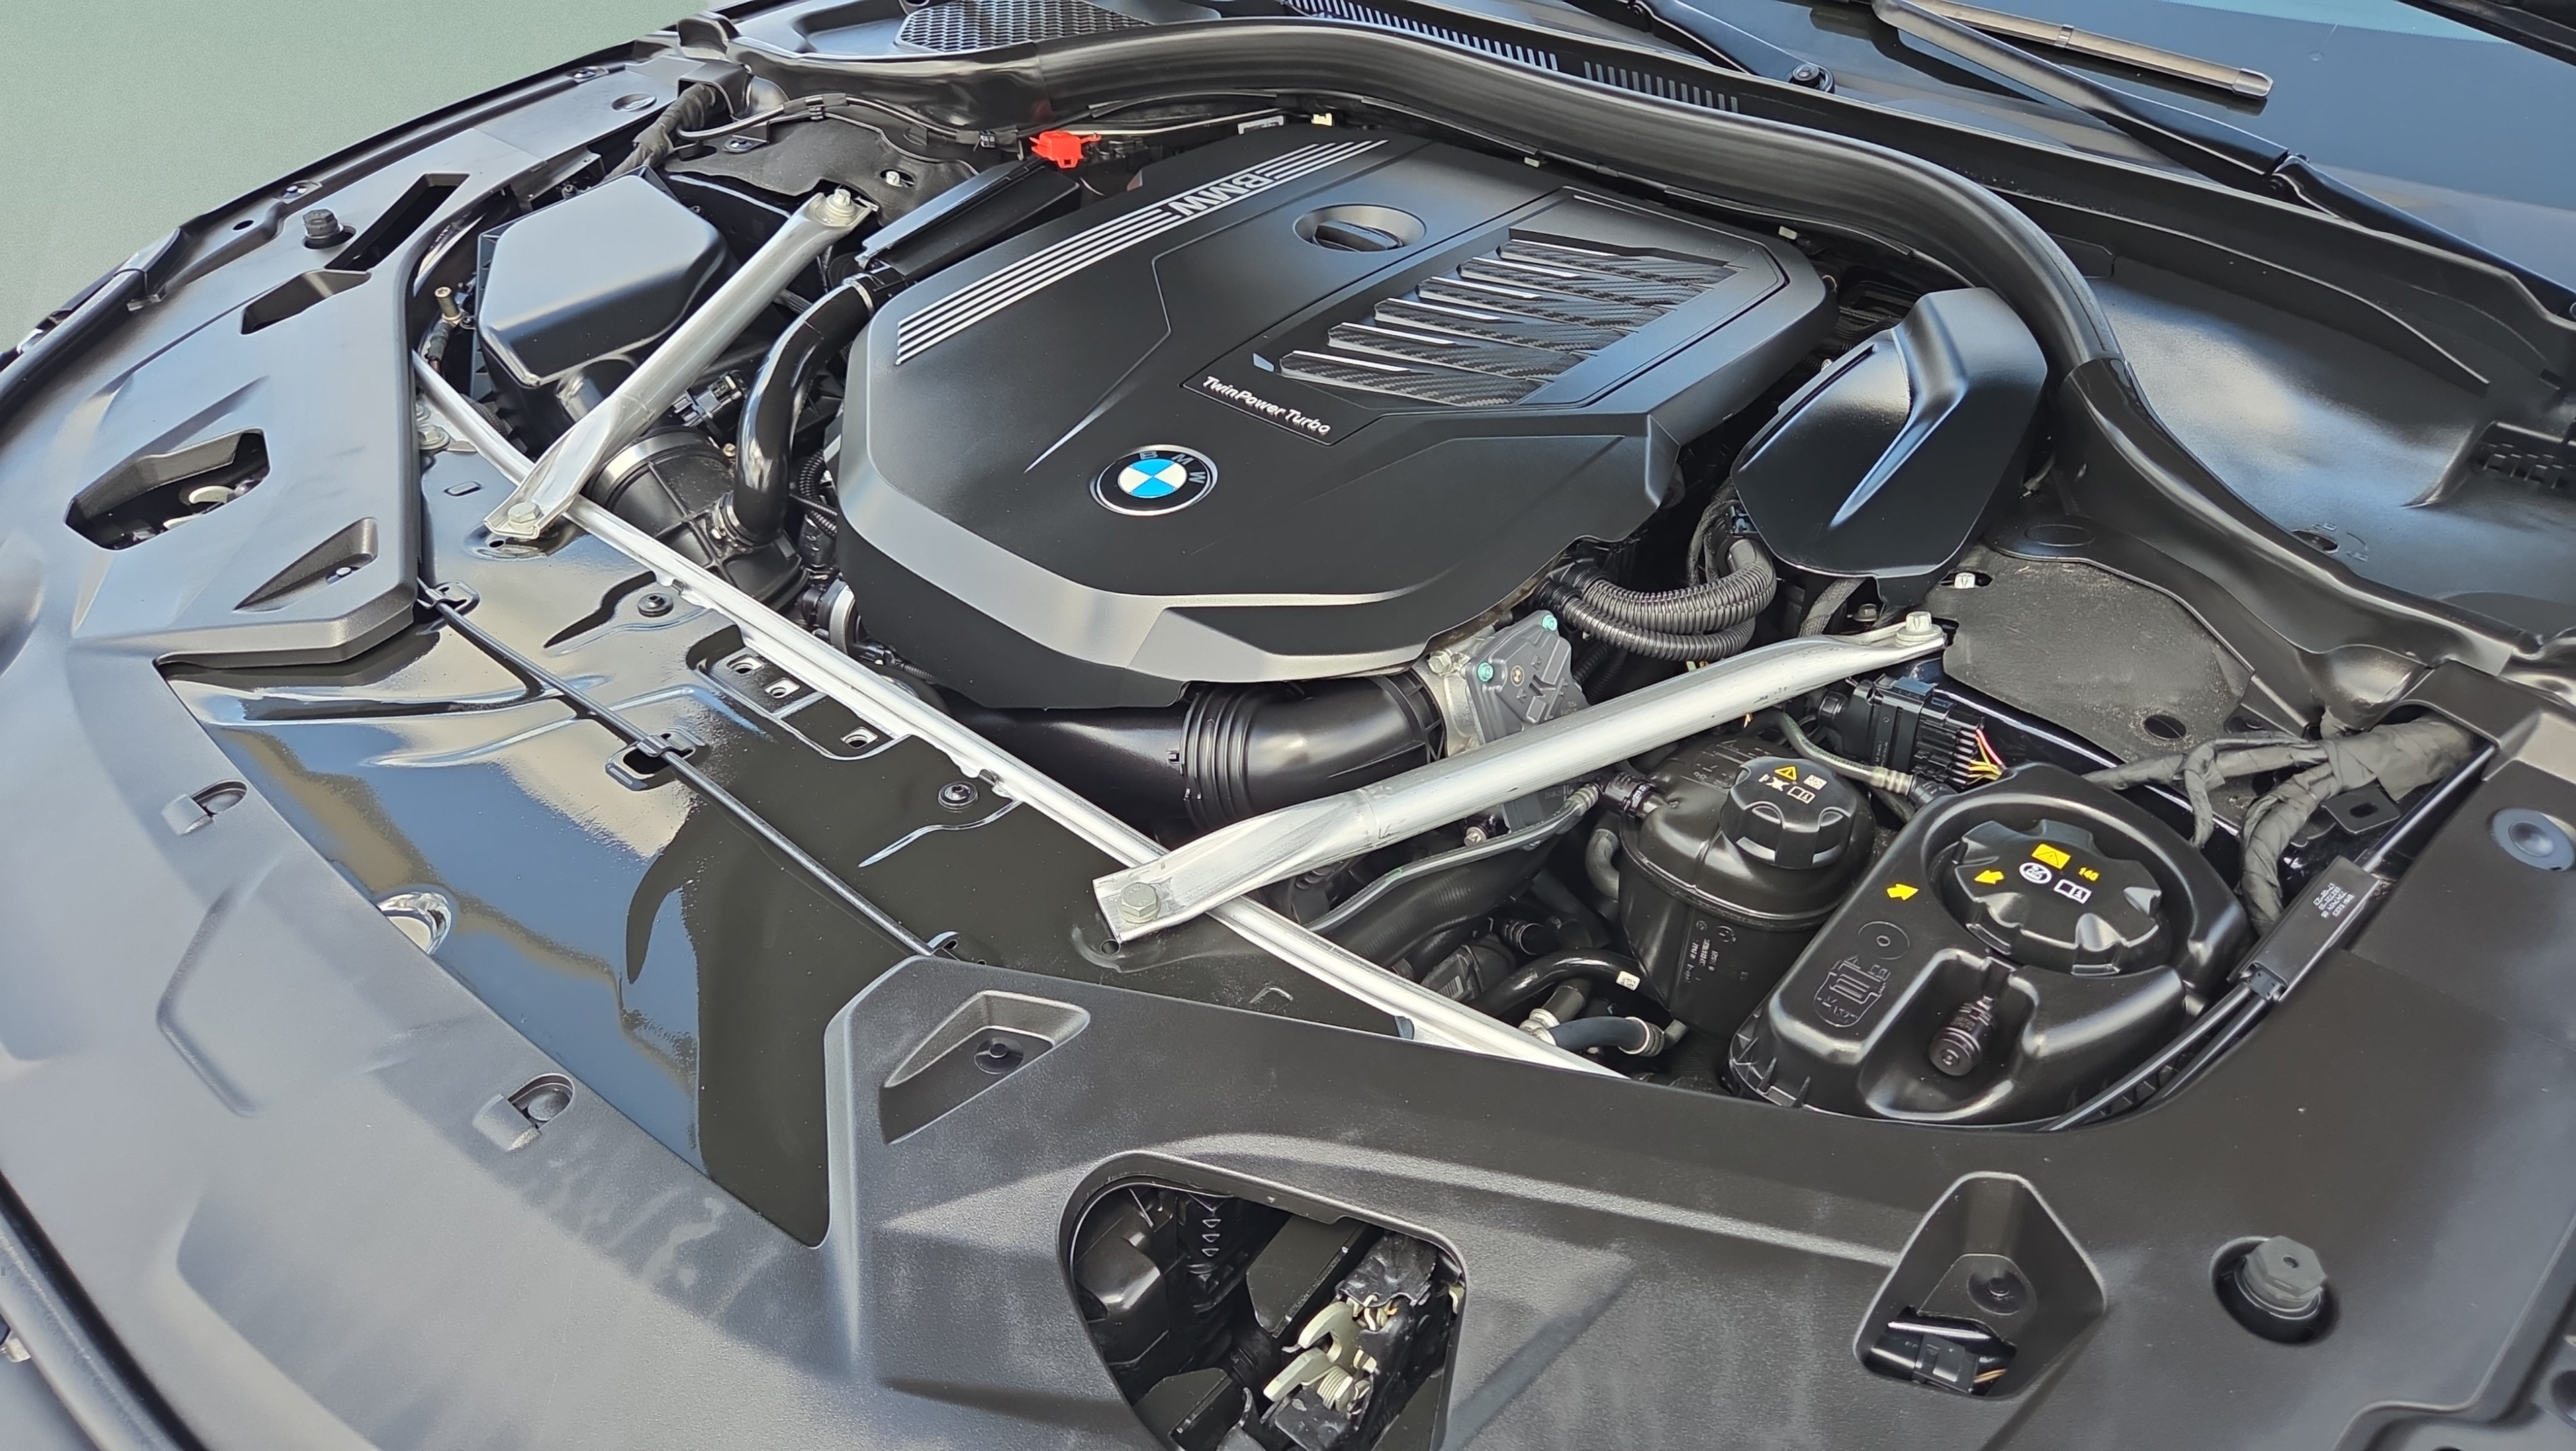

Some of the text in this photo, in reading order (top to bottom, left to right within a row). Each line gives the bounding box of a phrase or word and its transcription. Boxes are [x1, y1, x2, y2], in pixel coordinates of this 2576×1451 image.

[1168, 173, 1275, 217] BMW
[1202, 376, 1331, 434] TwinPower Turbo
[1139, 450, 1207, 484] BMW
[2078, 867, 2100, 881] 140
